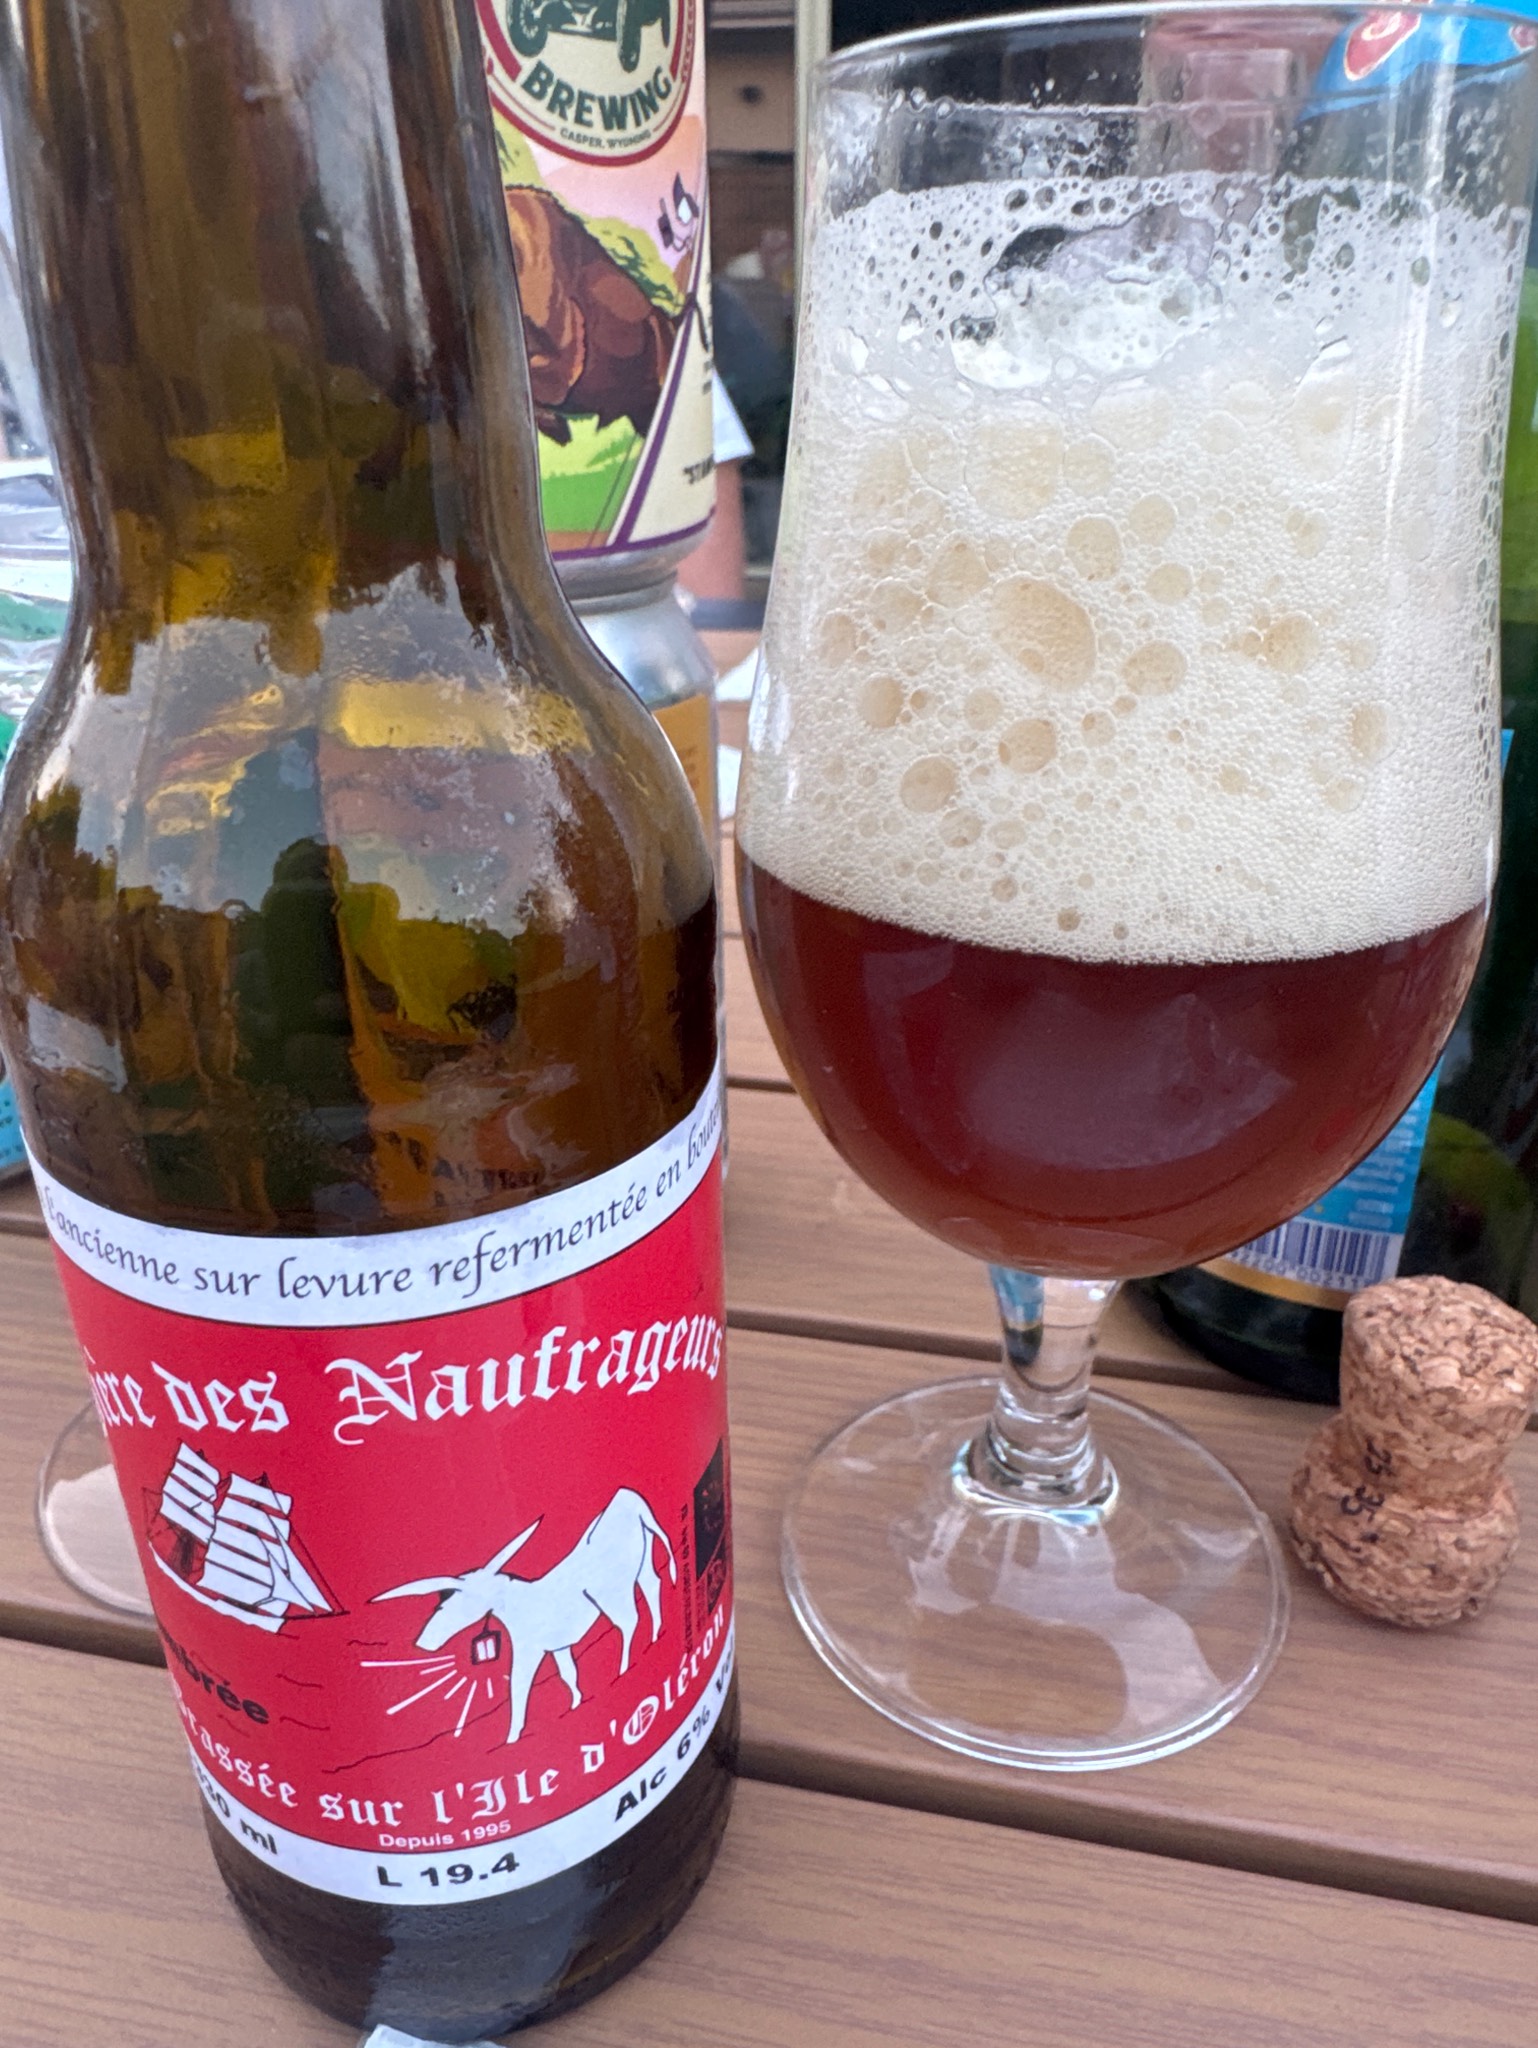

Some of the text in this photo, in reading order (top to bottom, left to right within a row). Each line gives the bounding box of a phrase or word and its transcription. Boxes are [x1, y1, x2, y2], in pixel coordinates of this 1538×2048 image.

[521, 60, 672, 131] BREWING
[560, 127, 605, 148] CASPER,
[194, 1266, 260, 1296] sur
[278, 1256, 413, 1298] levure
[429, 1182, 648, 1299] refermentée
[656, 1157, 681, 1198] en
[151, 1360, 290, 1433] des
[325, 1314, 723, 1446] Naufrageurs
[319, 1792, 403, 1827] sur
[580, 1604, 724, 1775] d'Oléron
[614, 1766, 667, 1823] Alc
[676, 1704, 711, 1761] 6%
[240, 1818, 278, 1855] ml
[377, 1852, 520, 1887] L 19.4
[379, 1820, 511, 1849] Depuis 1995
